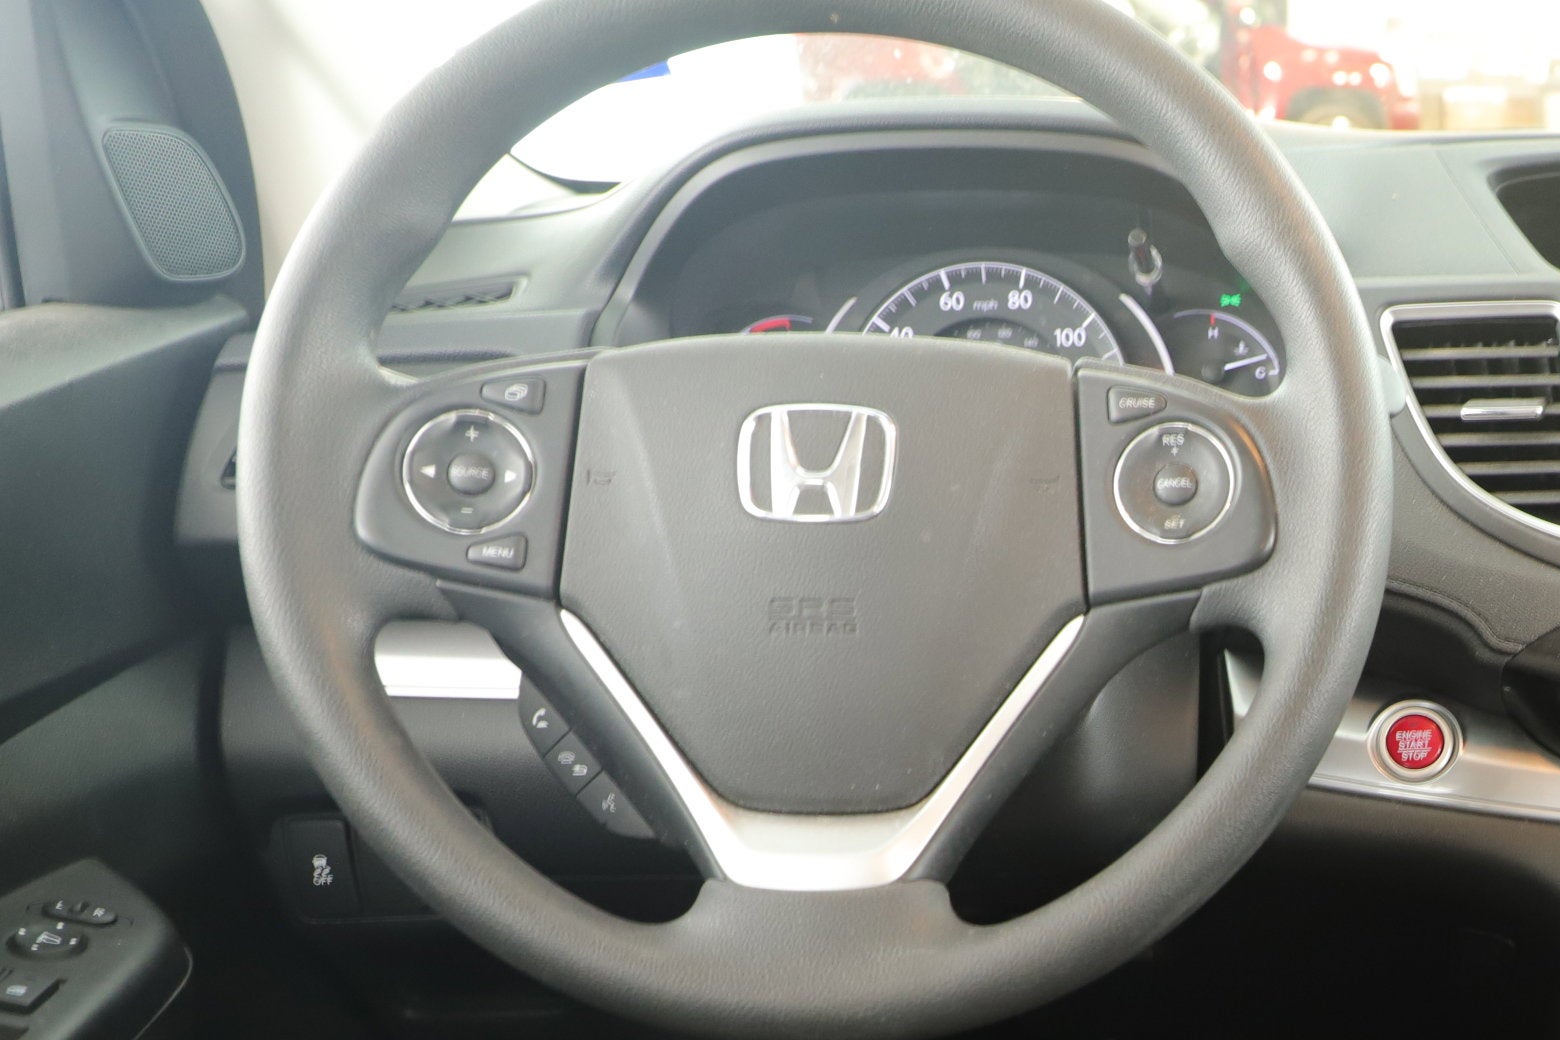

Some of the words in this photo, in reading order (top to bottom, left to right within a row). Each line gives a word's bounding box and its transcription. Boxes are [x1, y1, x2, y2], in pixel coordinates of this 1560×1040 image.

[939, 291, 965, 312] 60
[973, 299, 999, 314] mph
[1007, 290, 1033, 310] 80
[1053, 327, 1086, 348] 100
[1208, 326, 1219, 339] H
[1118, 397, 1156, 409] CRUISE
[1162, 434, 1185, 446] RES
[450, 464, 490, 480] SOURCE
[1157, 477, 1193, 490] CANCEL
[1163, 519, 1185, 530] SET
[481, 545, 515, 559] MENU
[767, 597, 858, 619] SRS
[767, 621, 860, 638] AIRBAG
[1395, 730, 1433, 740] ENGINE
[1398, 740, 1431, 749] START
[1401, 751, 1428, 761] STOP
[313, 874, 334, 886] OFF
